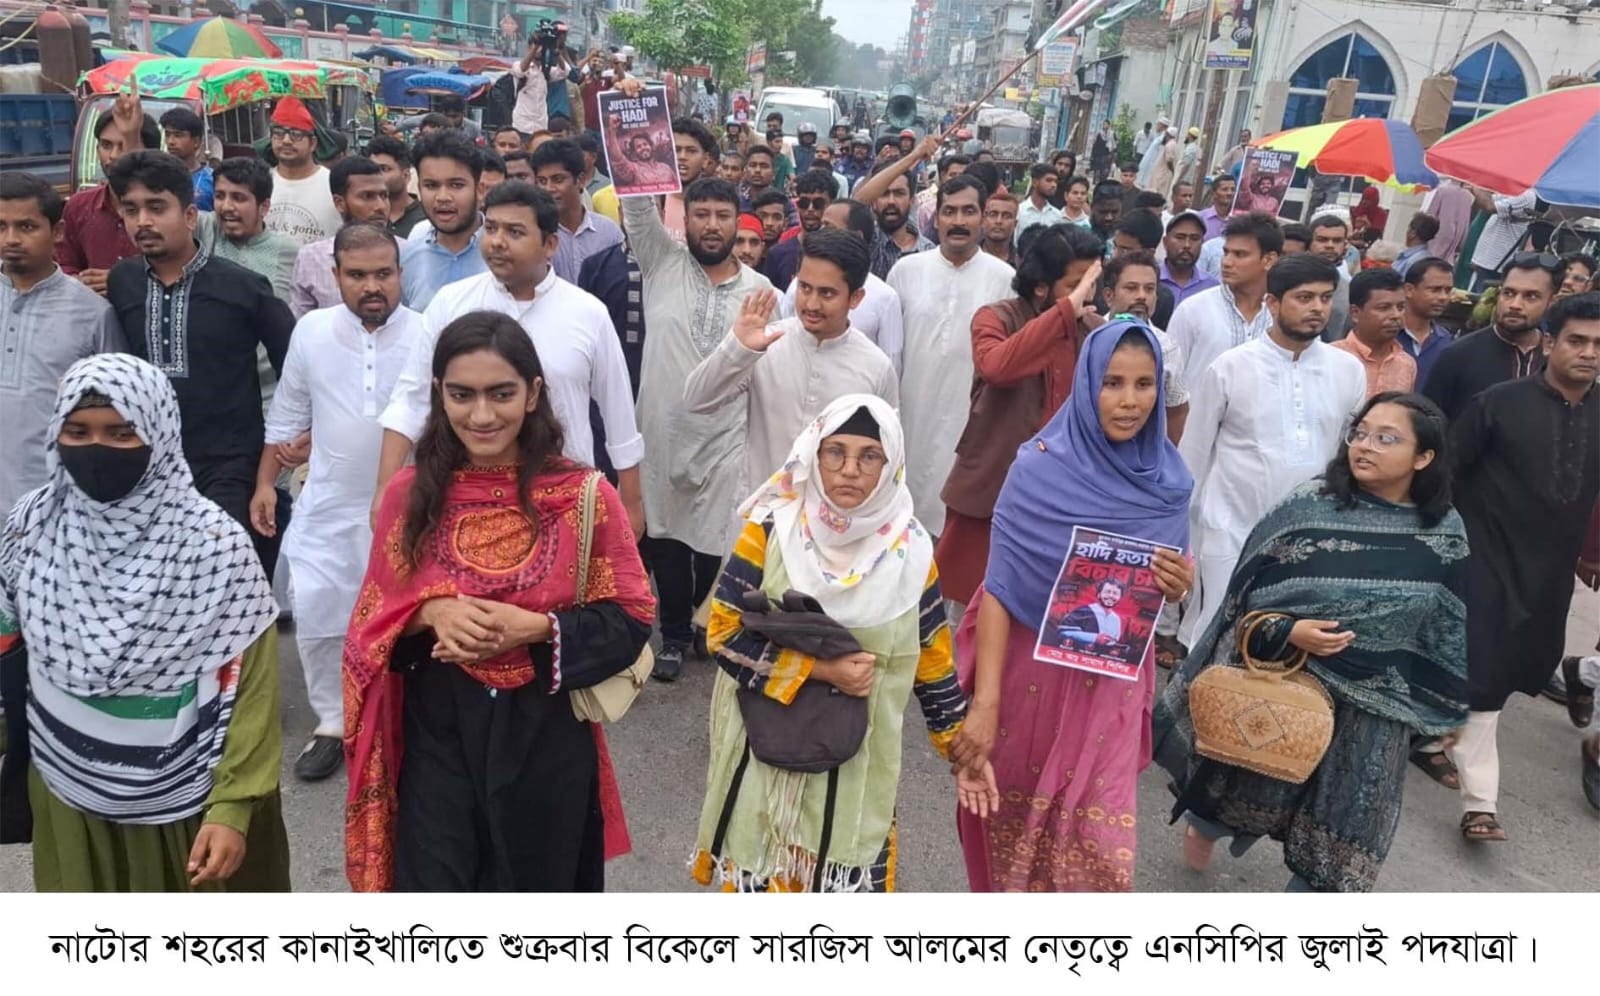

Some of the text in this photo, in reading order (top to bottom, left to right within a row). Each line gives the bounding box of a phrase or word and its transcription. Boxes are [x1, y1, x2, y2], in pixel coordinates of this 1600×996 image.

[608, 96, 659, 111] JUSTICE FOR
[620, 109, 647, 122] HADI
[1252, 150, 1292, 161] JUSTICE FOR
[1260, 158, 1281, 168] HADI
[1075, 541, 1113, 560] হাদি
[1067, 556, 1132, 585] বিচার
